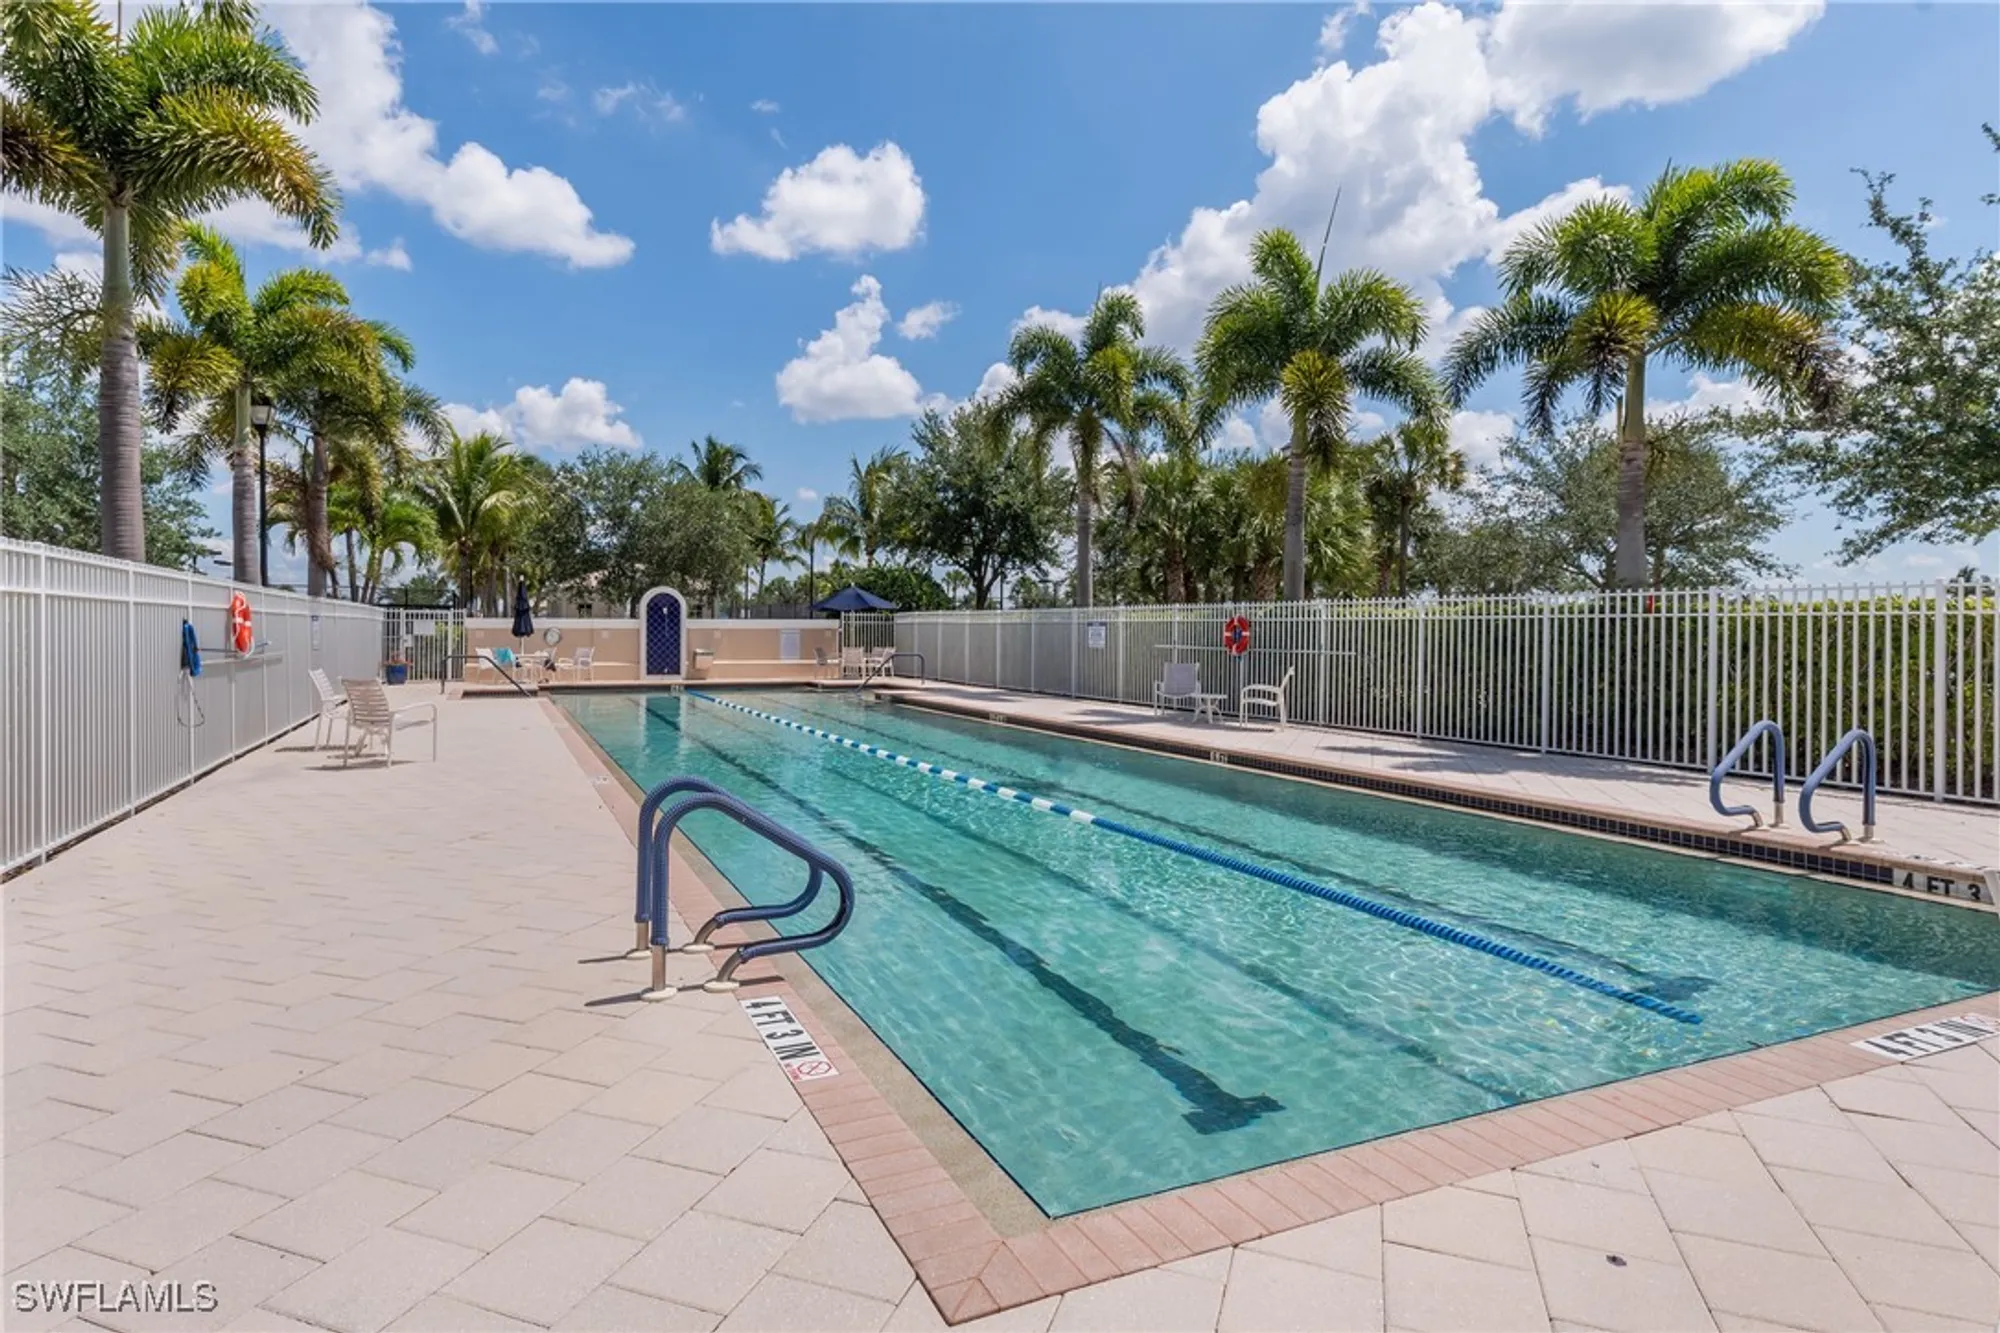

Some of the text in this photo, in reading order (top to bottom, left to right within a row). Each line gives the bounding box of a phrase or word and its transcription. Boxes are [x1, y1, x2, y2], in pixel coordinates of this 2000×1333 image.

[1926, 876, 1955, 896] FT
[751, 1009, 796, 1026] FT
[773, 1041, 821, 1060] IN
